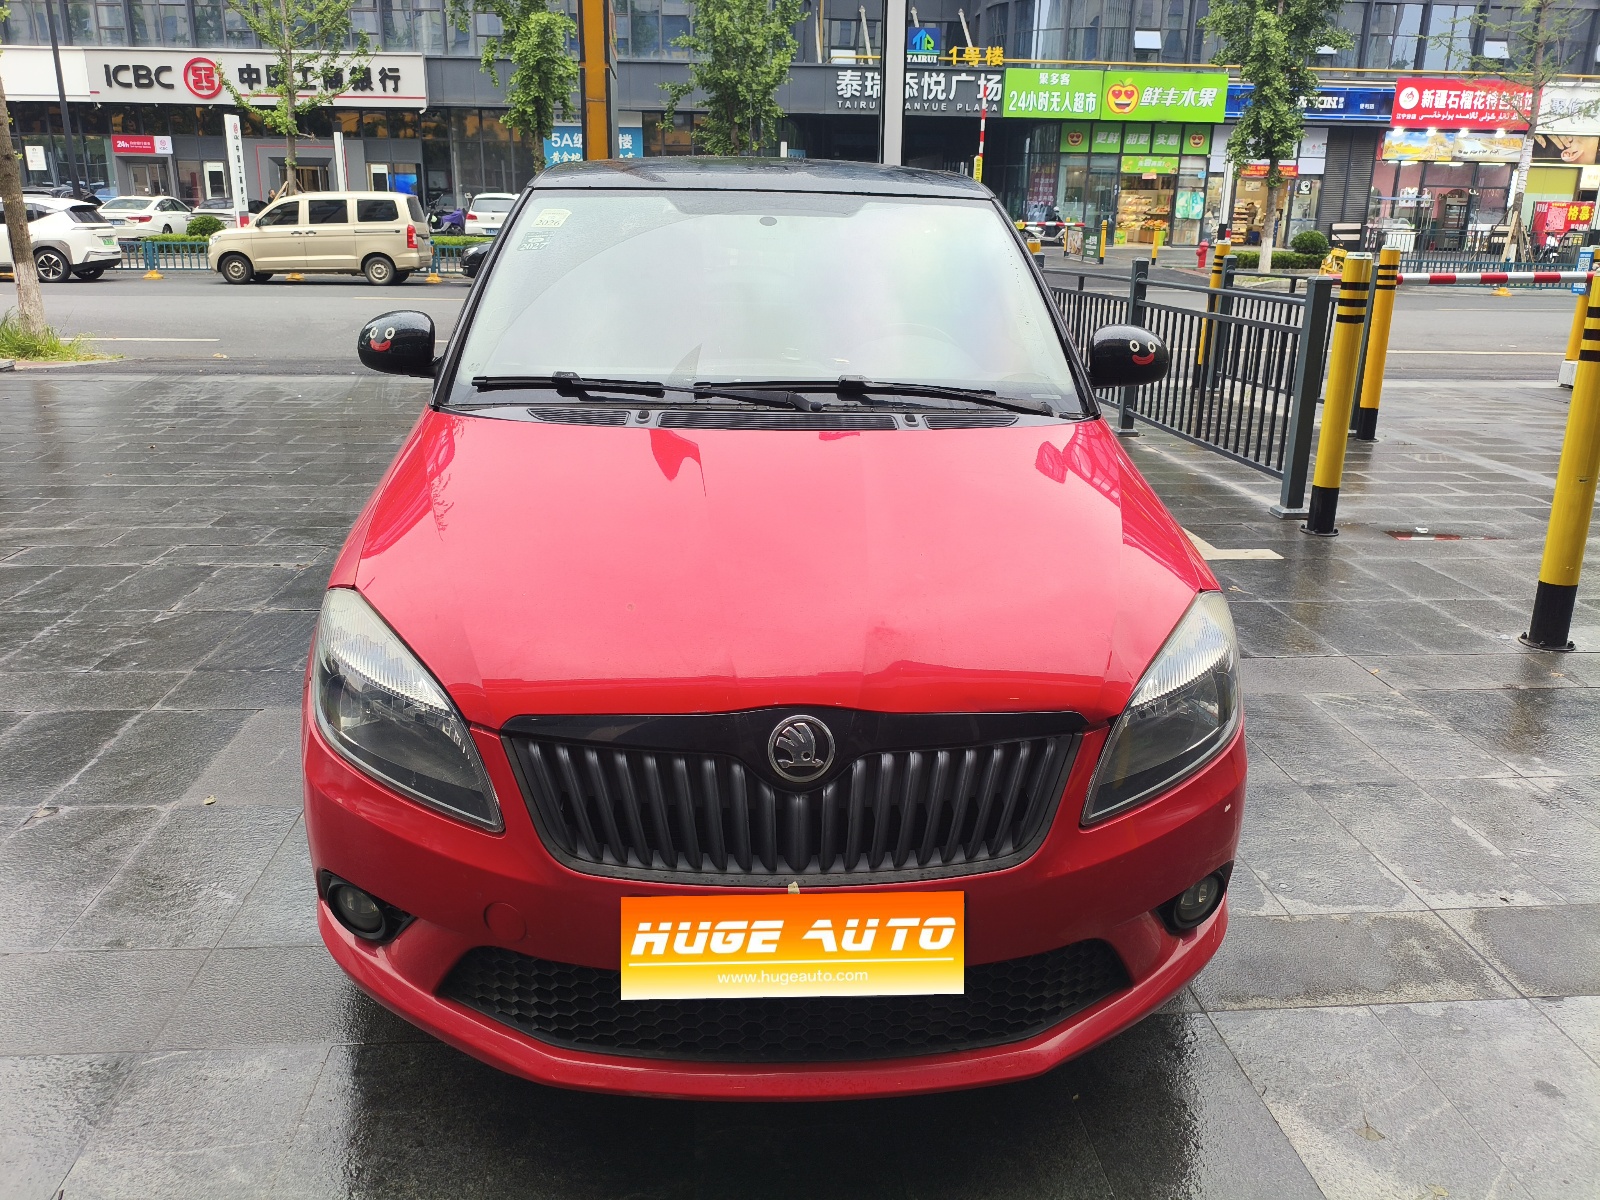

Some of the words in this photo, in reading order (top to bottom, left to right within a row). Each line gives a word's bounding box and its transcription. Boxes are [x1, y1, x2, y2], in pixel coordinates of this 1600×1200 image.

[906, 54, 938, 63] TAIRUI
[949, 45, 1004, 66] 1号楼
[104, 64, 175, 90] ICBC
[1038, 72, 1071, 86] 聚多客
[837, 100, 876, 109] TAIRU
[1008, 90, 1097, 114] 24小时无人超市
[1139, 86, 1217, 108] 鲜丰水果
[551, 132, 633, 150] 5A级楼
[1095, 131, 1120, 145] 更鲜
[1126, 133, 1150, 146] 甜更
[1568, 204, 1595, 221] 格慕
[535, 219, 560, 227] 2026
[518, 242, 550, 251] 2027
